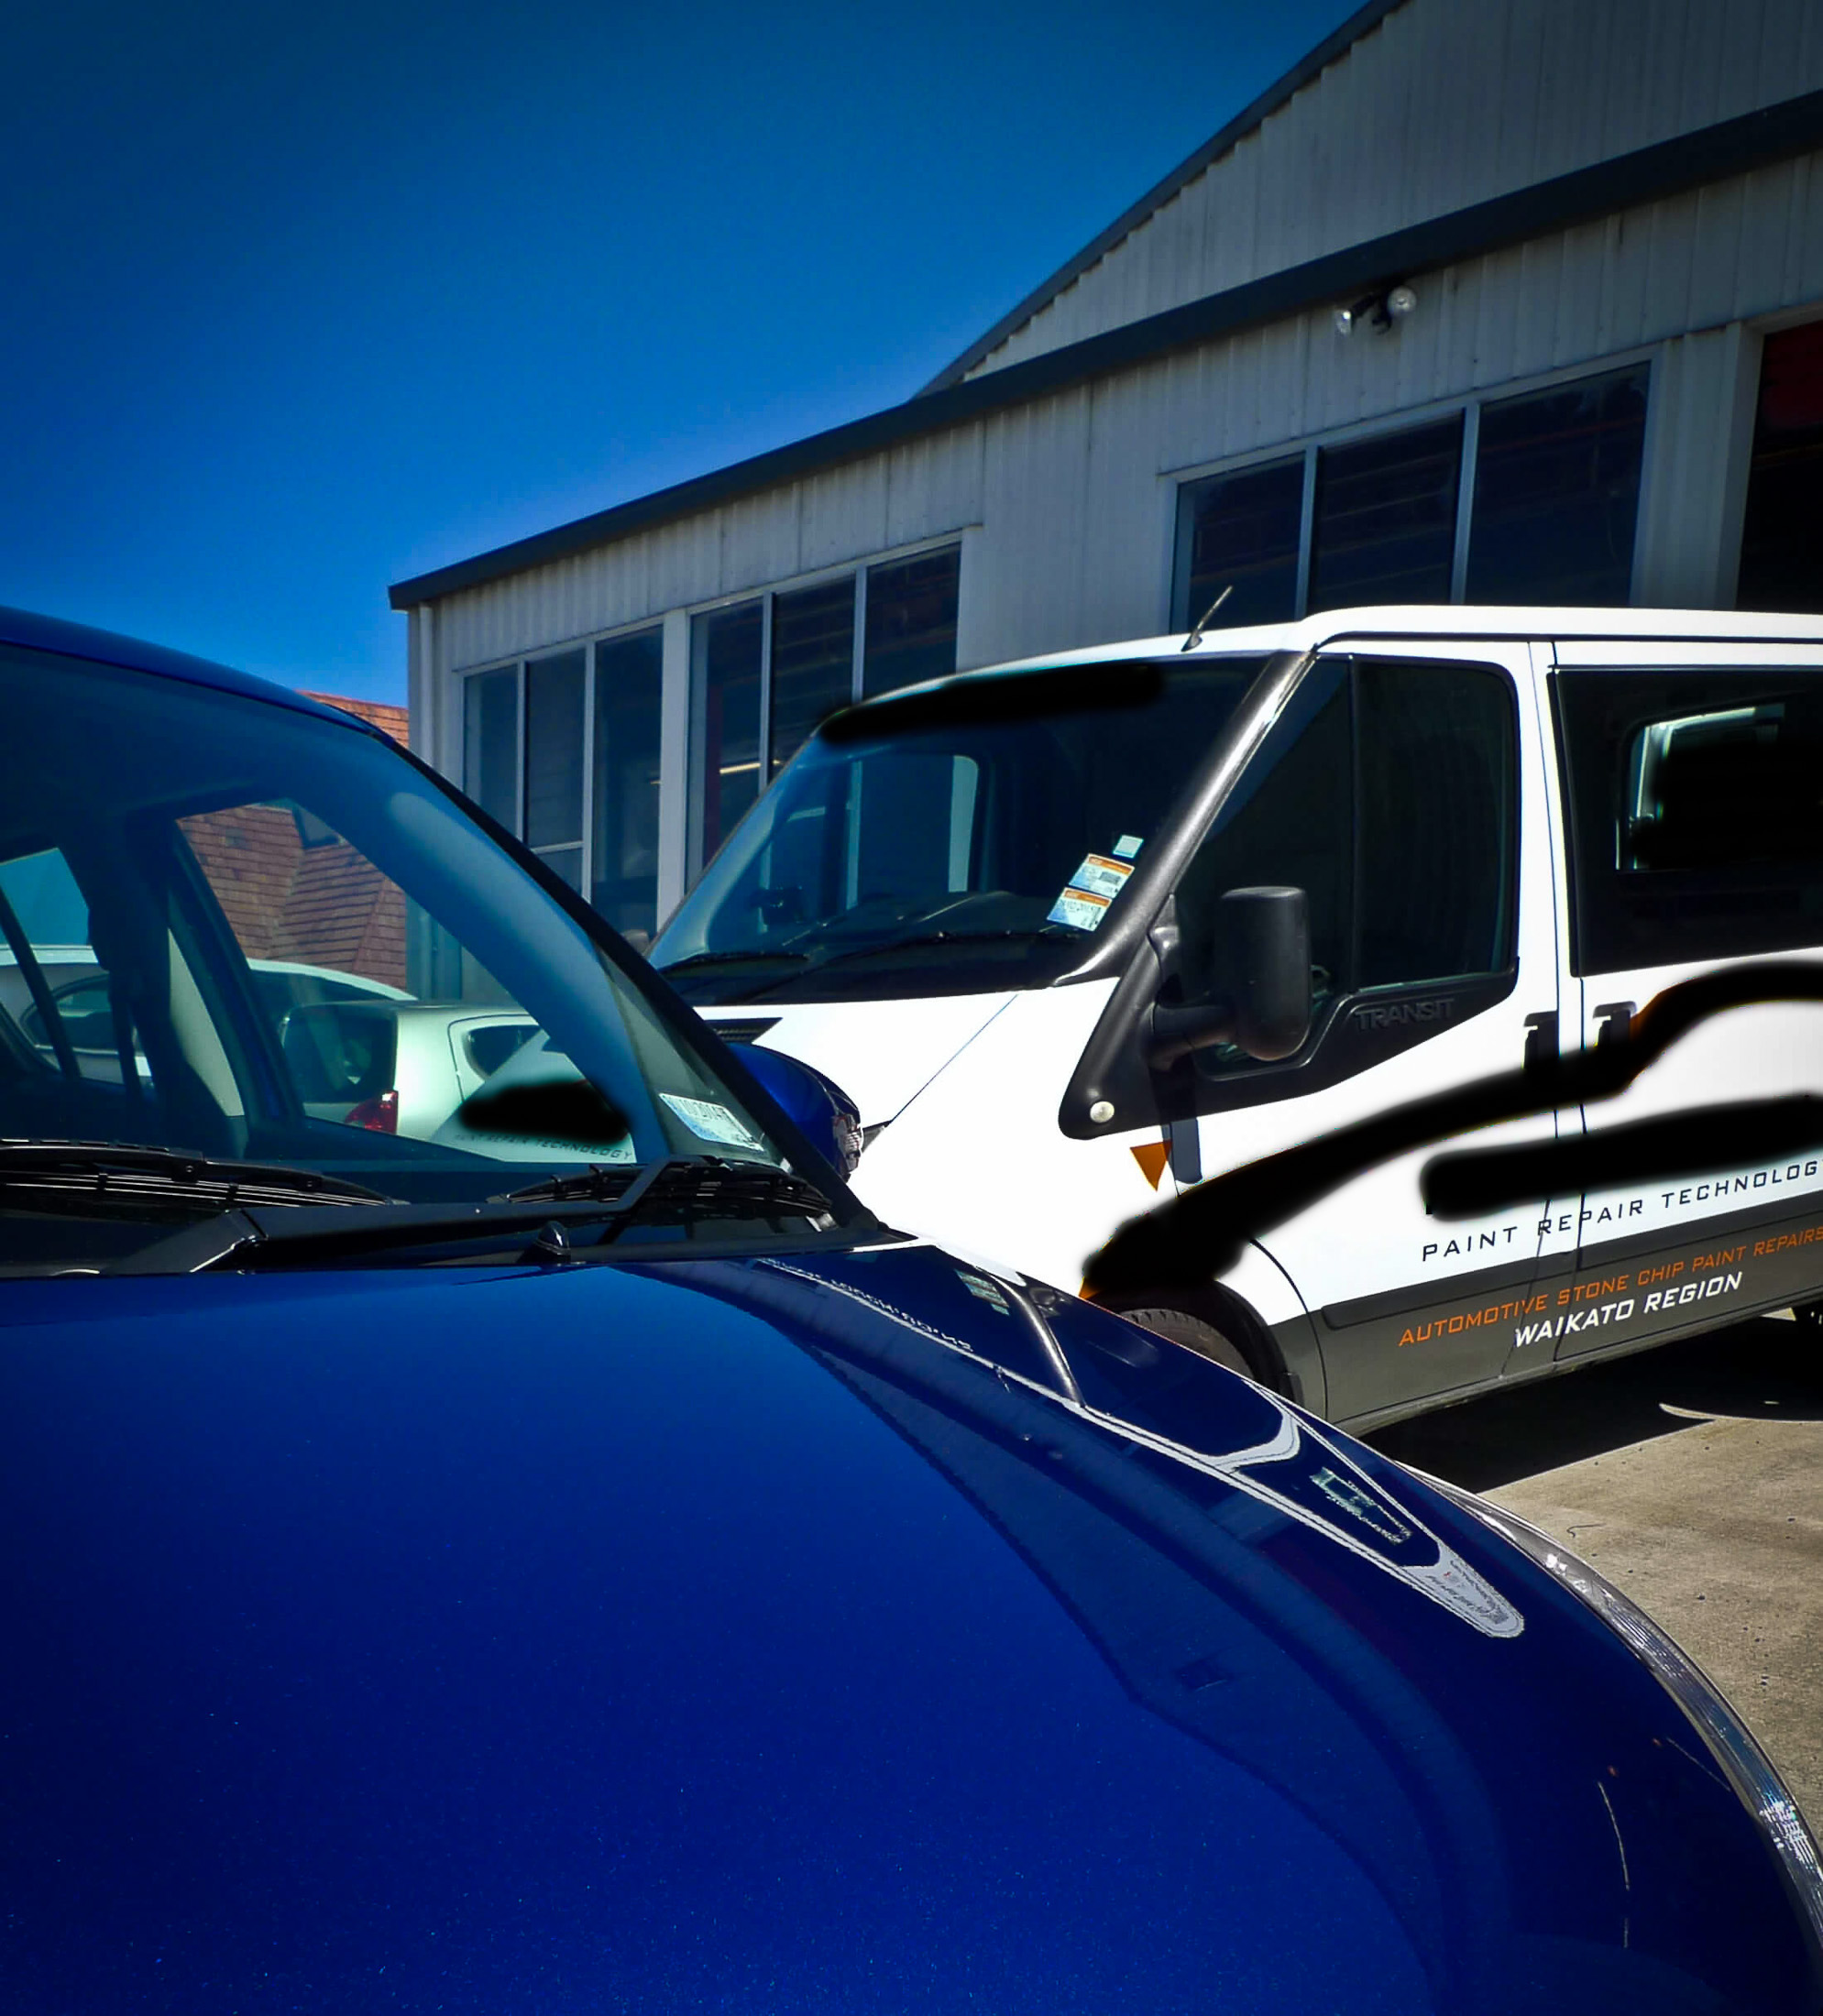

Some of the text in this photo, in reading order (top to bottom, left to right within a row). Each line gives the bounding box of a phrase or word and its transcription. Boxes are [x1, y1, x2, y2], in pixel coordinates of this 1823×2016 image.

[1355, 998, 1455, 1033] TRANSIT
[535, 1138, 632, 1160] TECHNOLOGY
[1422, 1160, 1823, 1262] PAINT REPAIR TECHNOLOG
[1398, 1225, 1823, 1347] AUTOMOTIVE STONE CHIP PAINT REPAIRS
[1515, 1271, 1742, 1348] WAIKATO REGION
